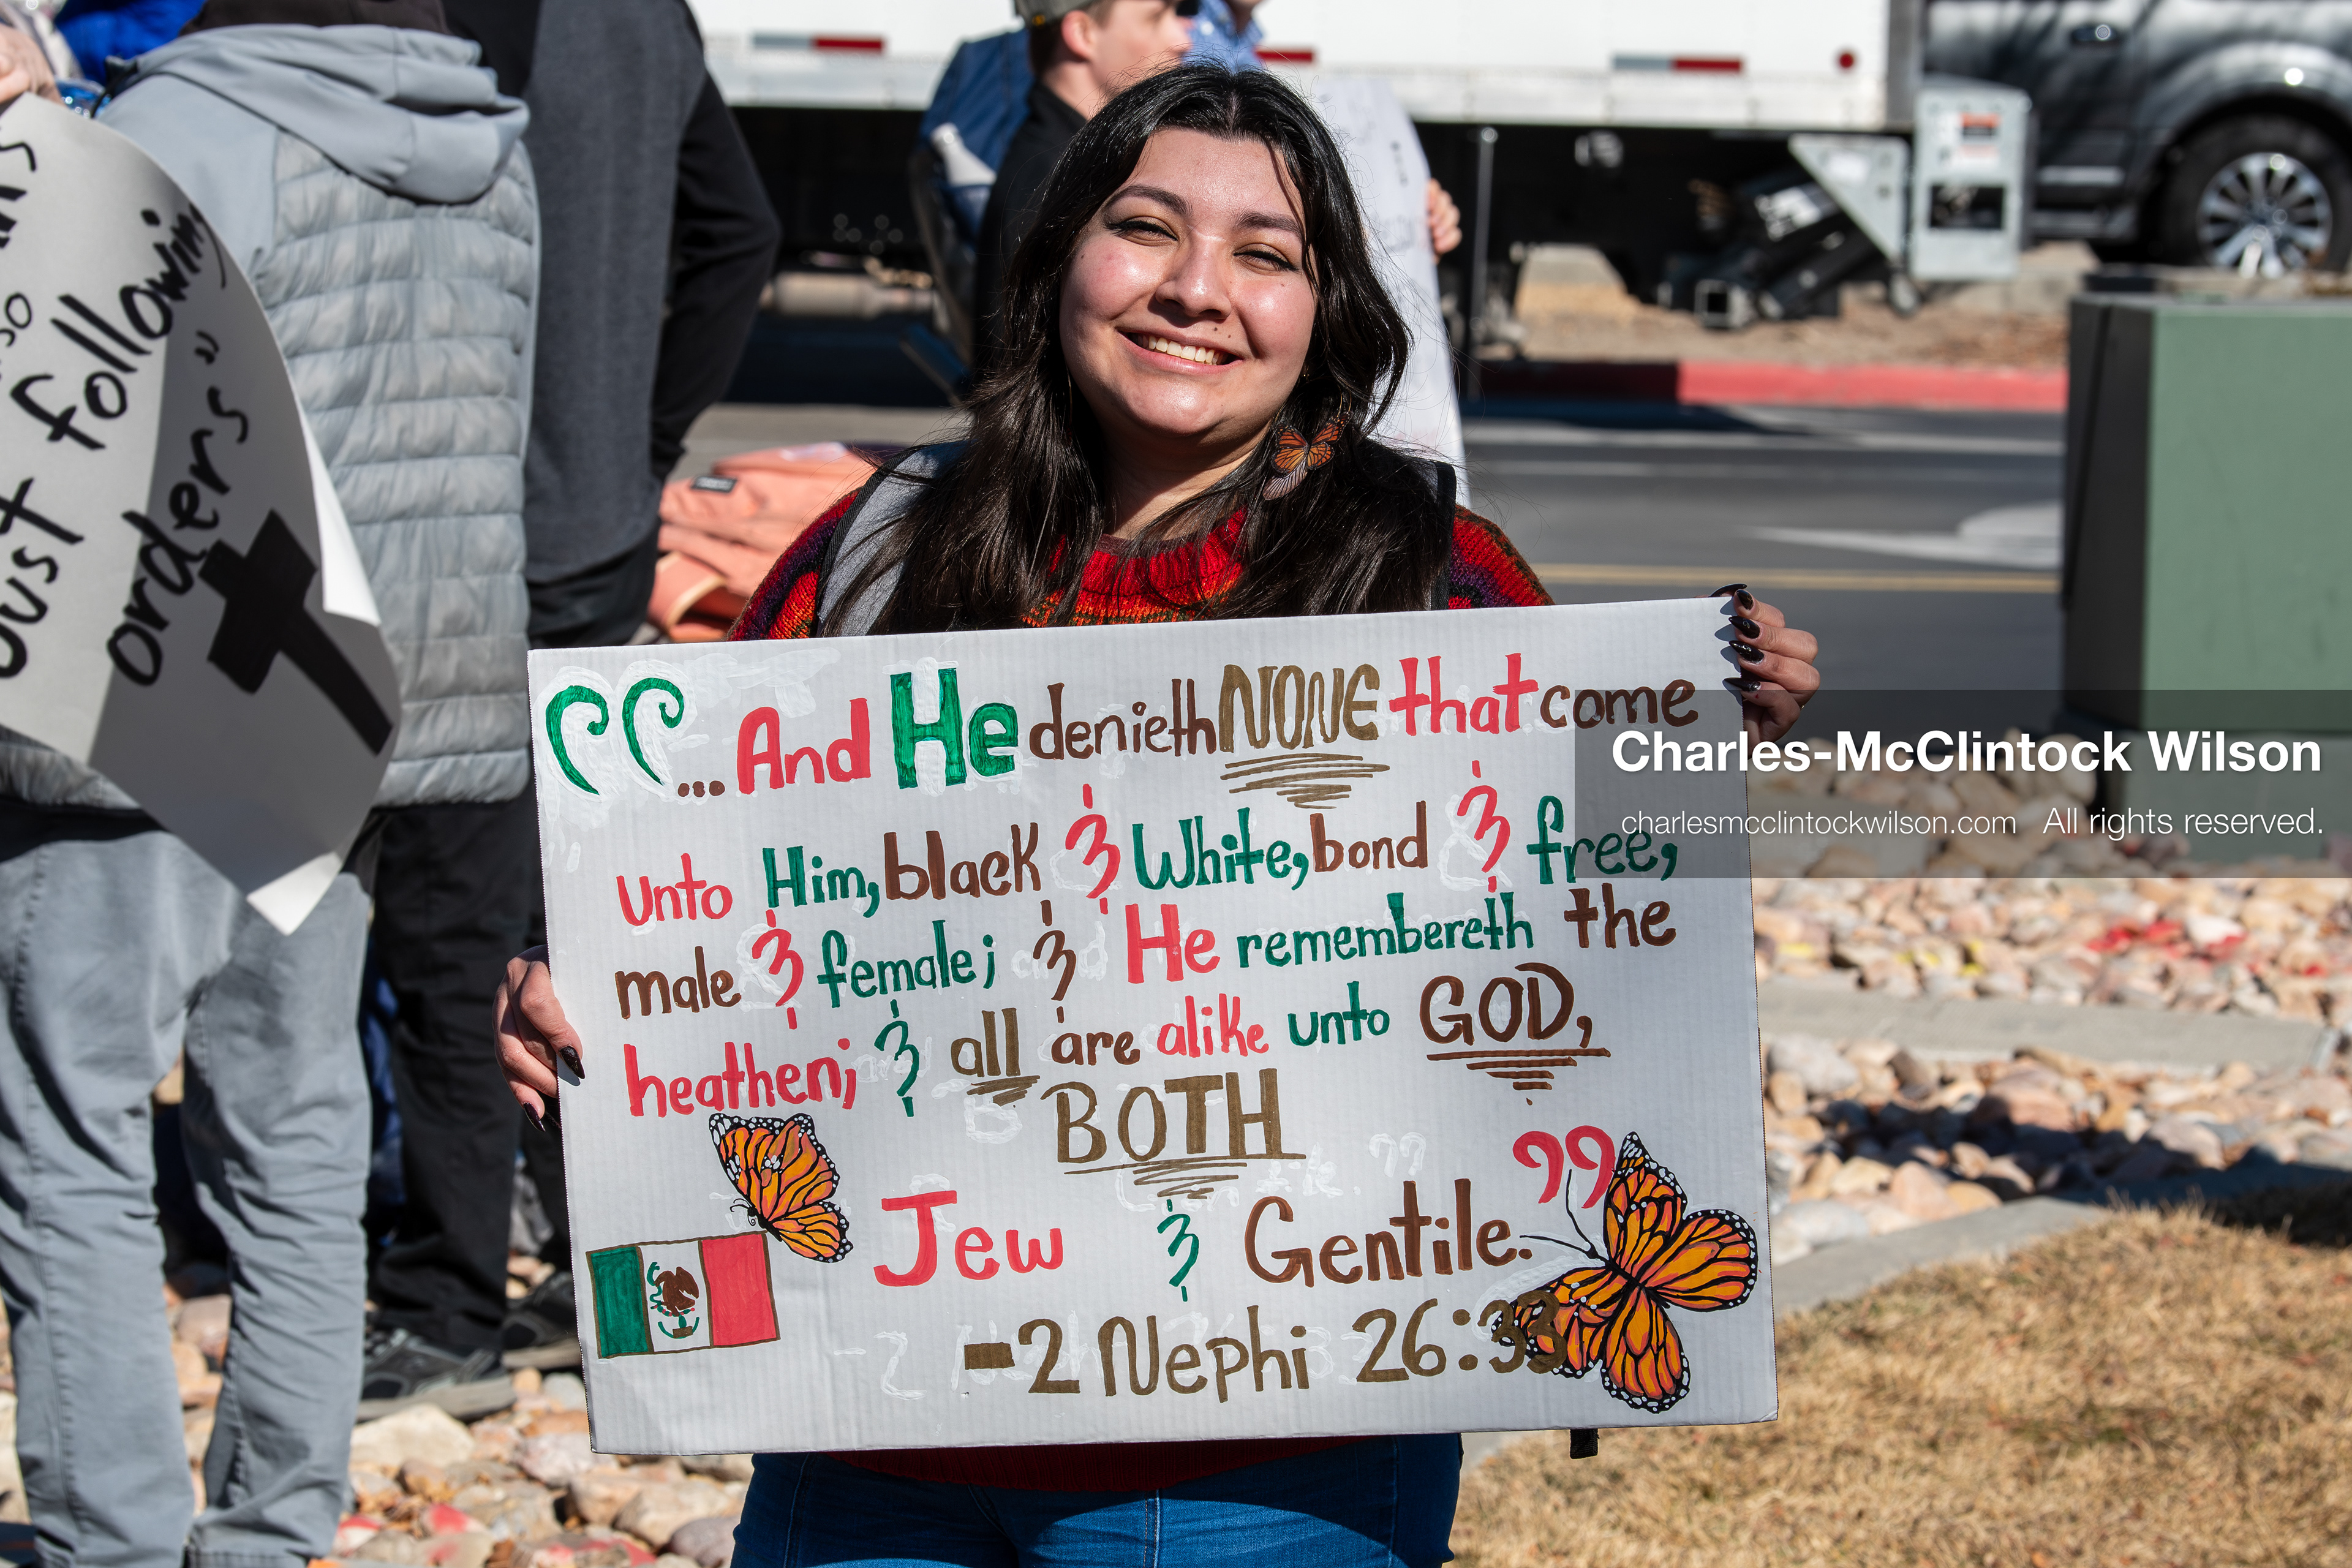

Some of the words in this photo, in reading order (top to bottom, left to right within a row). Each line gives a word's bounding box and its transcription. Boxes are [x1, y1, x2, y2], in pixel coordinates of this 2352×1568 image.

[737, 698, 871, 794] And
[890, 668, 1018, 789] He
[1030, 679, 1216, 760] denieth
[1219, 664, 1379, 753] NONE
[1389, 653, 1539, 736] that
[1540, 680, 1698, 728] come
[763, 846, 880, 919] Him,
[1133, 805, 1310, 890] White,
[1309, 801, 1428, 872] bond
[1526, 796, 1678, 886] free,
[615, 946, 741, 1019] male
[817, 920, 995, 1009] female;
[1125, 903, 1220, 984] He
[1237, 892, 1535, 969] remembereth
[1564, 883, 1676, 949] the
[624, 1038, 856, 1118] heathen;
[951, 1008, 1020, 1077] all
[1052, 1031, 1140, 1065] are
[1288, 981, 1390, 1046] unto
[1420, 963, 1592, 1049] GOD,
[1041, 1069, 1284, 1162] BOTH
[873, 1190, 1063, 1287] Jew
[1245, 1178, 1532, 1287] Gentile.
[1098, 1306, 1309, 1403] Nephi
